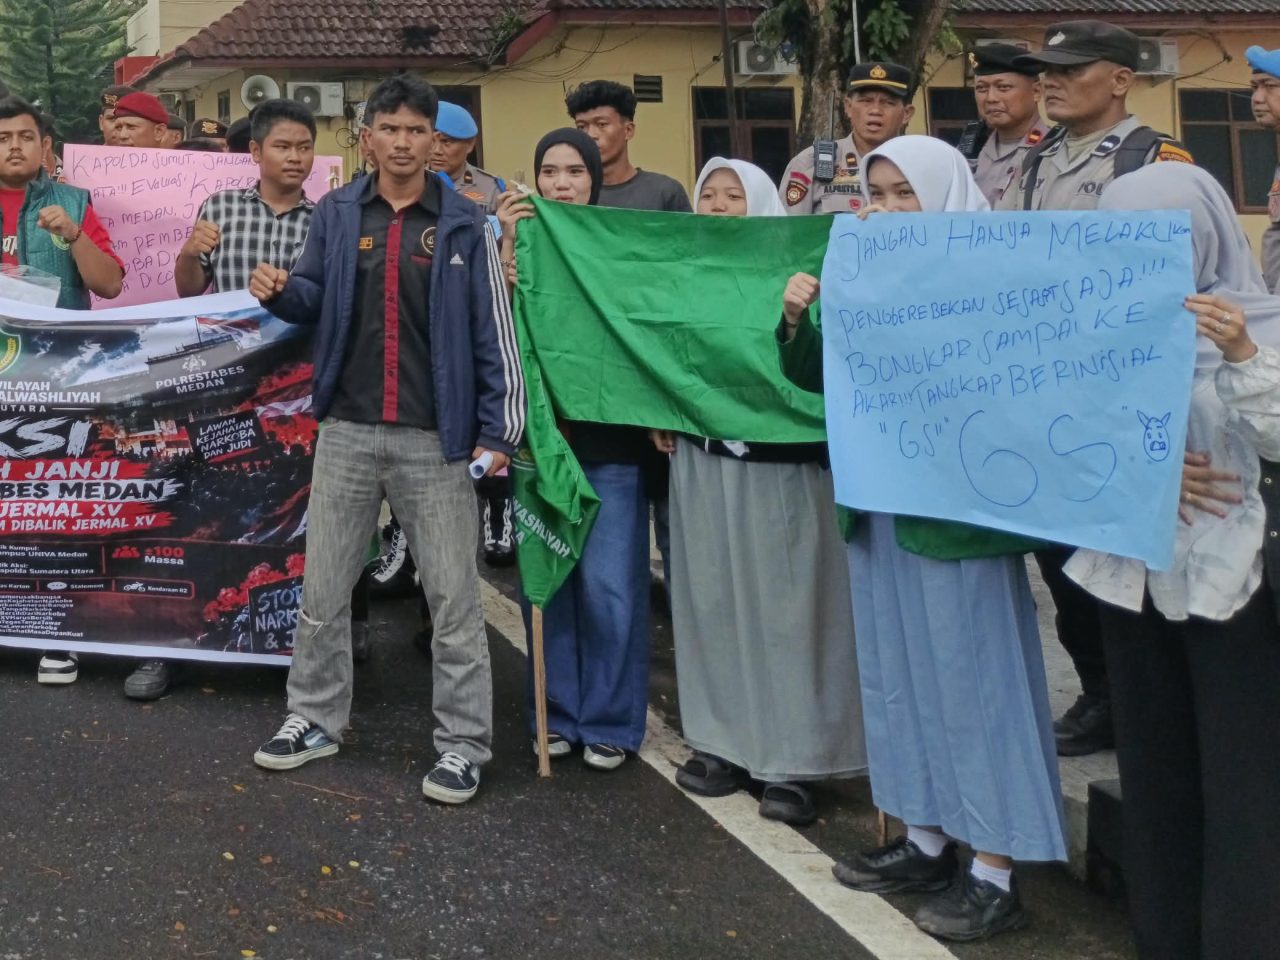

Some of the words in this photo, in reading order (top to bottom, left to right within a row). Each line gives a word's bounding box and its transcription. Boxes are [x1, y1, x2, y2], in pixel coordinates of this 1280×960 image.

[838, 224, 928, 282] JANGAN
[946, 218, 1030, 255] HANYA
[844, 339, 972, 386] BONGKAR
[1094, 301, 1150, 330] KE
[155, 365, 245, 389] POLRESTABES
[175, 378, 225, 394] MEDAN
[0, 403, 47, 412] UTARA
[196, 419, 254, 446] KEJAHATAN
[200, 417, 236, 435] LAWAN
[200, 428, 256, 453] NARKOBA
[203, 447, 223, 460] DAN
[227, 439, 252, 453] JUDI
[24, 460, 120, 480] JANJI
[57, 481, 165, 500] MEDAN
[91, 503, 124, 517] XV
[11, 519, 67, 531] DIBALIK
[71, 517, 129, 531] JERMAL
[134, 514, 157, 527] XV
[144, 555, 184, 566] Massa
[255, 608, 297, 633] NARK
